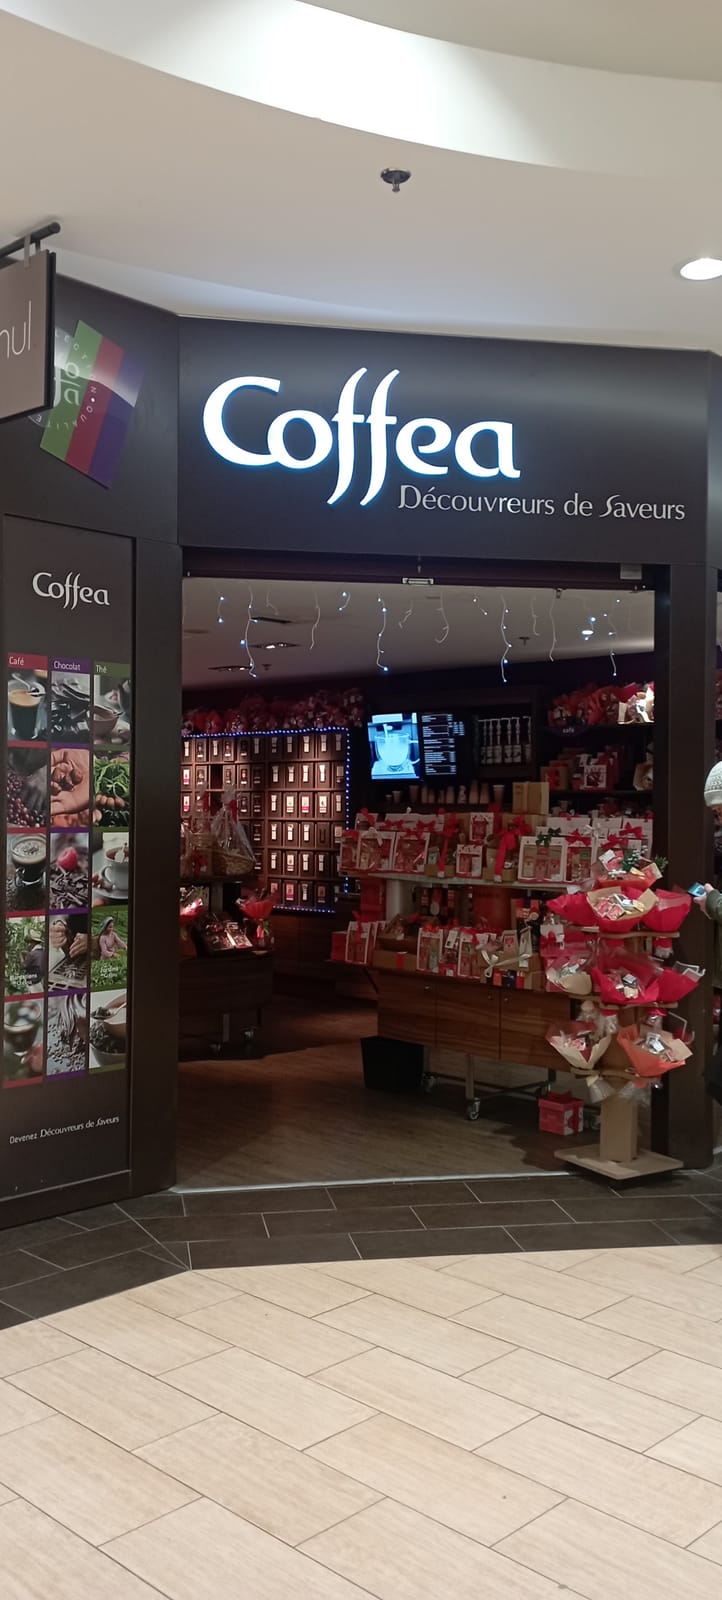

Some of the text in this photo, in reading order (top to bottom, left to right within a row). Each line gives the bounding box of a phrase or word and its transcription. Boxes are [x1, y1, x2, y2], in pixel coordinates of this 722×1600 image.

[203, 368, 520, 506] Coffea
[397, 484, 686, 520] Découvreurs de Saveurs
[32, 571, 110, 610] Coffea
[9, 656, 25, 666] Café
[53, 660, 81, 671] Chocolat
[96, 665, 107, 673] Thé
[9, 1116, 120, 1145] Devenez Découvreurs de Saveurs
